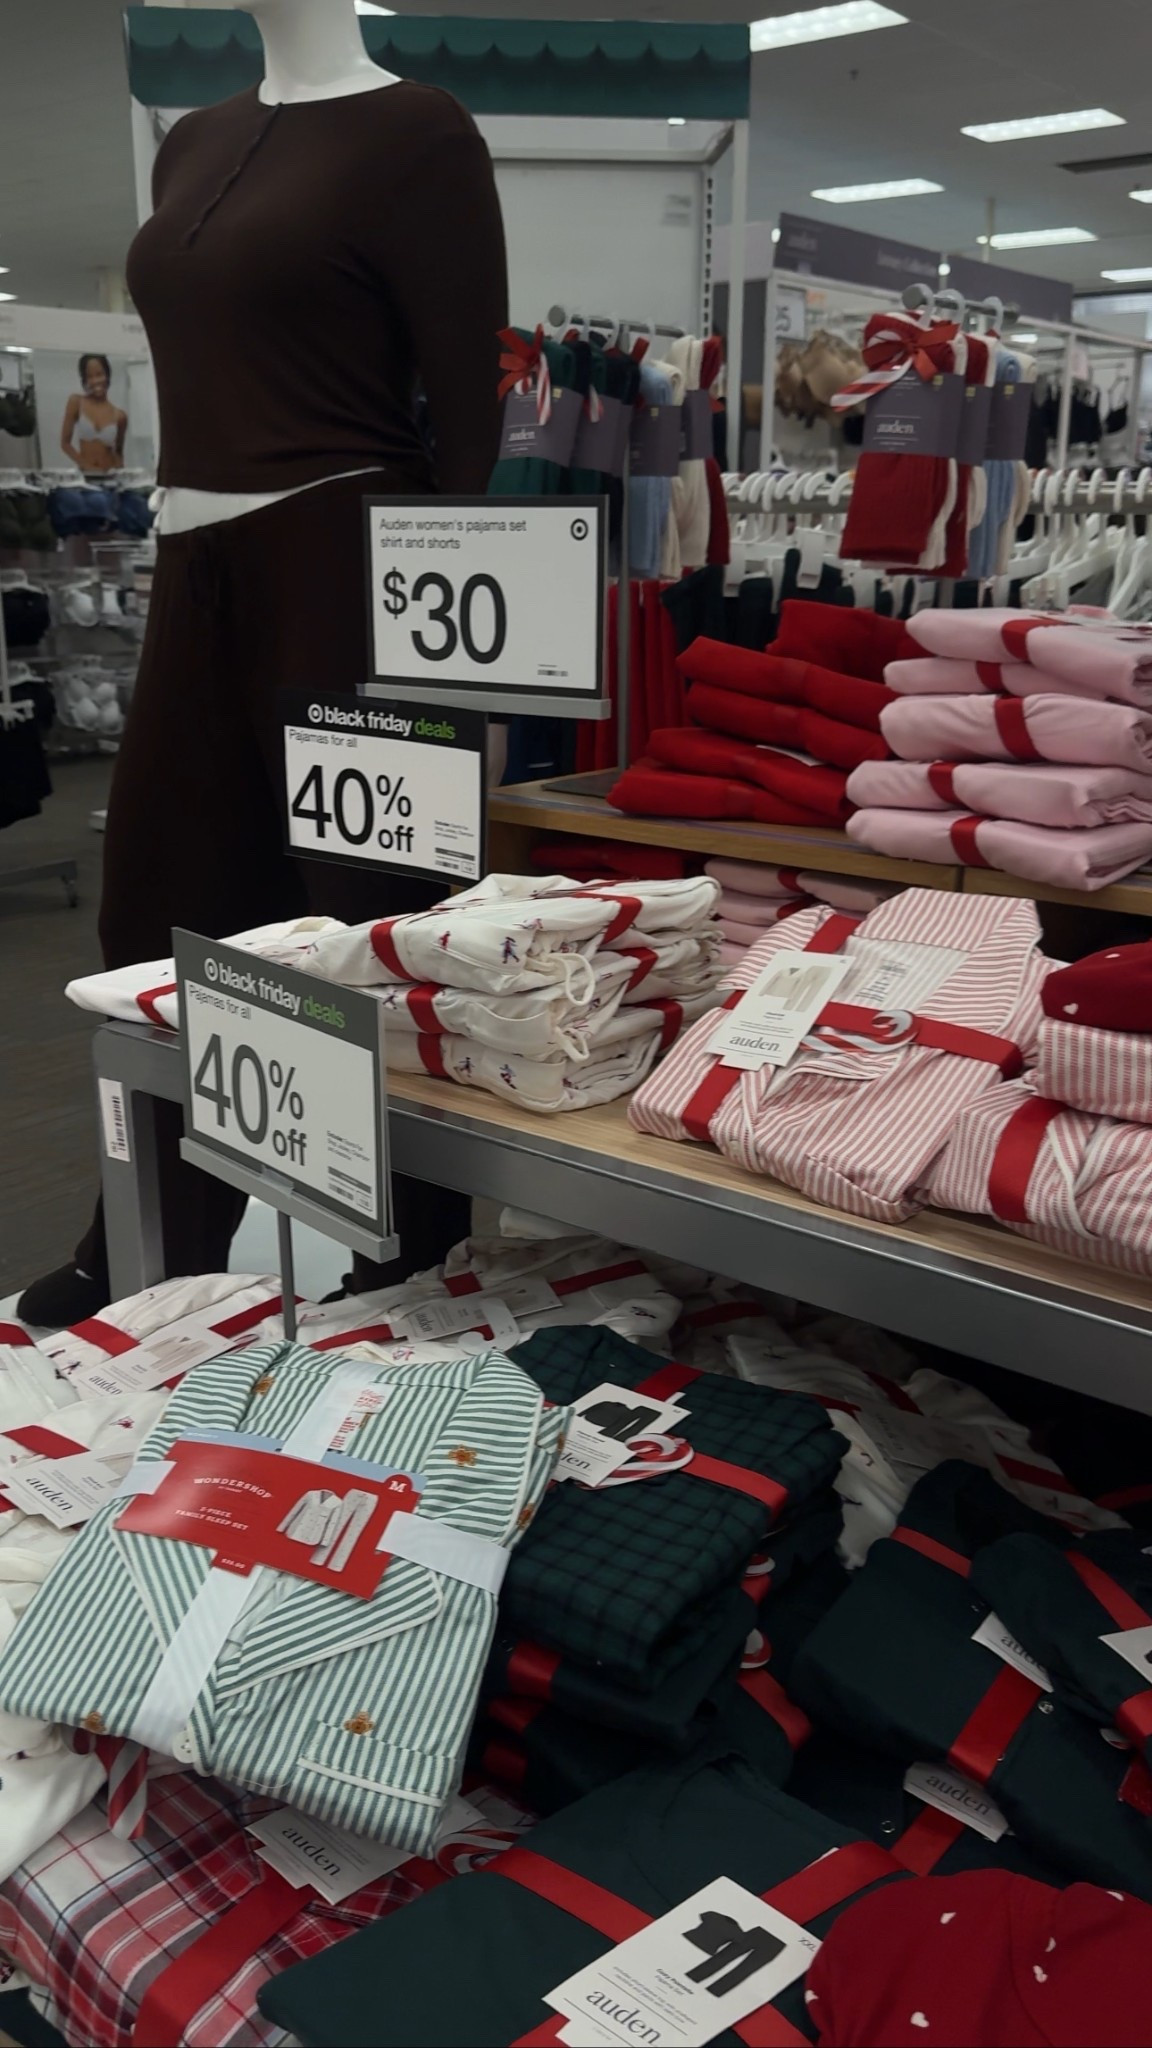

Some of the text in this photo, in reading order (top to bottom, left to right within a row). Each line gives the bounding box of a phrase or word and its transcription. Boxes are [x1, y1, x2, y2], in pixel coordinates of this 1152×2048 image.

[380, 518, 527, 535] Auden women's pajama set
[380, 536, 461, 549] shirt and shorts
[383, 566, 507, 664] $30
[289, 728, 358, 748] Pajamas for all
[324, 706, 456, 740] black friday deals
[378, 825, 415, 853] off
[188, 984, 251, 1021] Pajamas for all
[219, 962, 346, 1030] black friday deals
[729, 1034, 780, 1052] auden
[272, 1128, 308, 1167] off
[88, 1374, 123, 1396] auden
[25, 1476, 74, 1512] auden
[193, 1477, 273, 1500] WONDERSHOP
[388, 1480, 408, 1493] M
[204, 1514, 232, 1529] SLEEP
[230, 1520, 249, 1532] SET
[926, 1774, 993, 1816] auden
[281, 1826, 341, 1877] auden
[585, 1989, 662, 2046] auden
